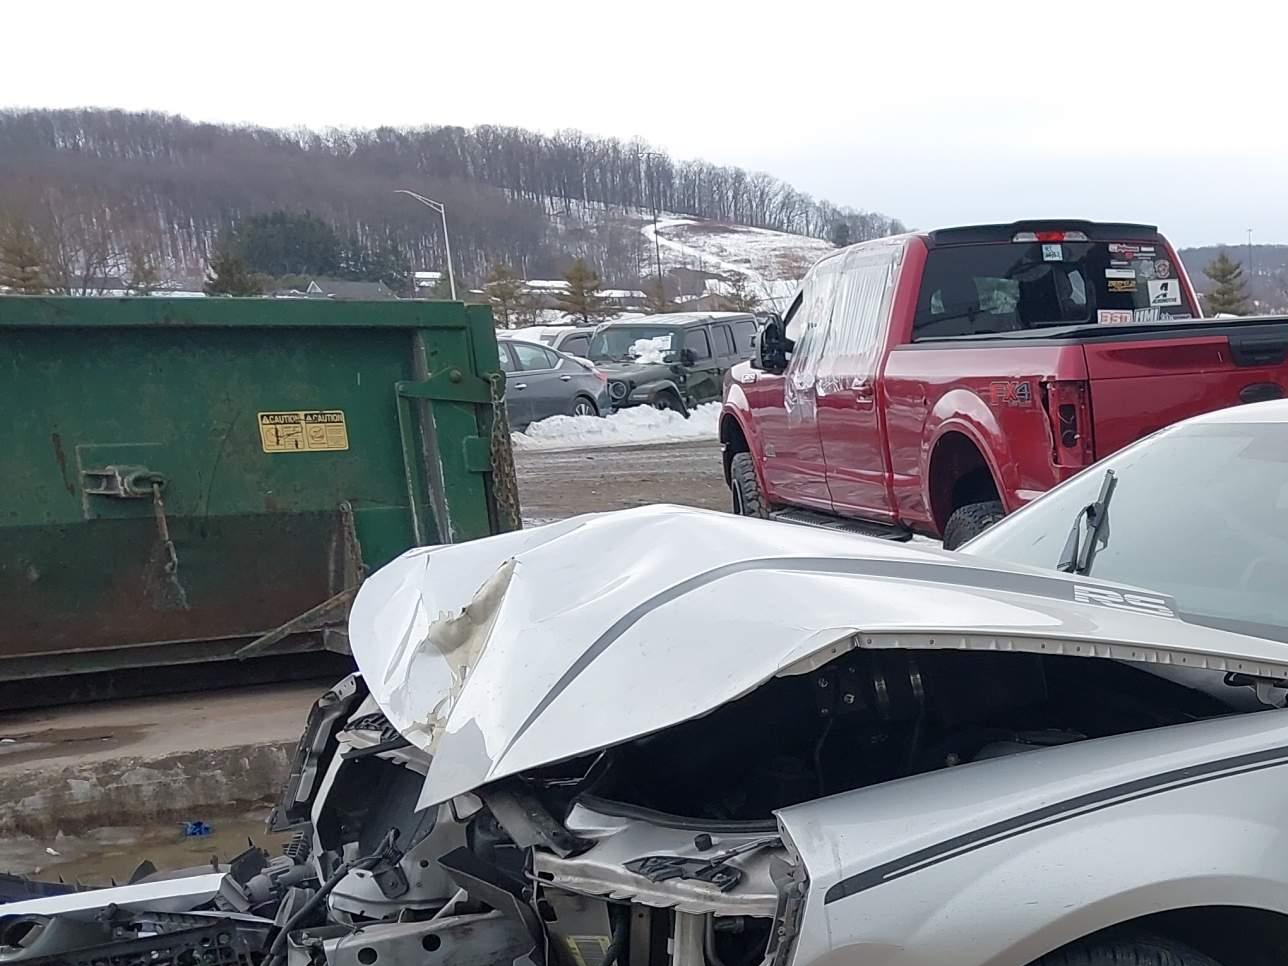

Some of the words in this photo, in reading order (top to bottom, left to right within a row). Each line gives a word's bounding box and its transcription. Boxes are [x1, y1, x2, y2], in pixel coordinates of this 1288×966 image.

[991, 381, 1030, 402] FX4
[268, 415, 299, 424] CAUTION
[312, 413, 343, 423] CAUTION
[1074, 584, 1174, 618] RS
